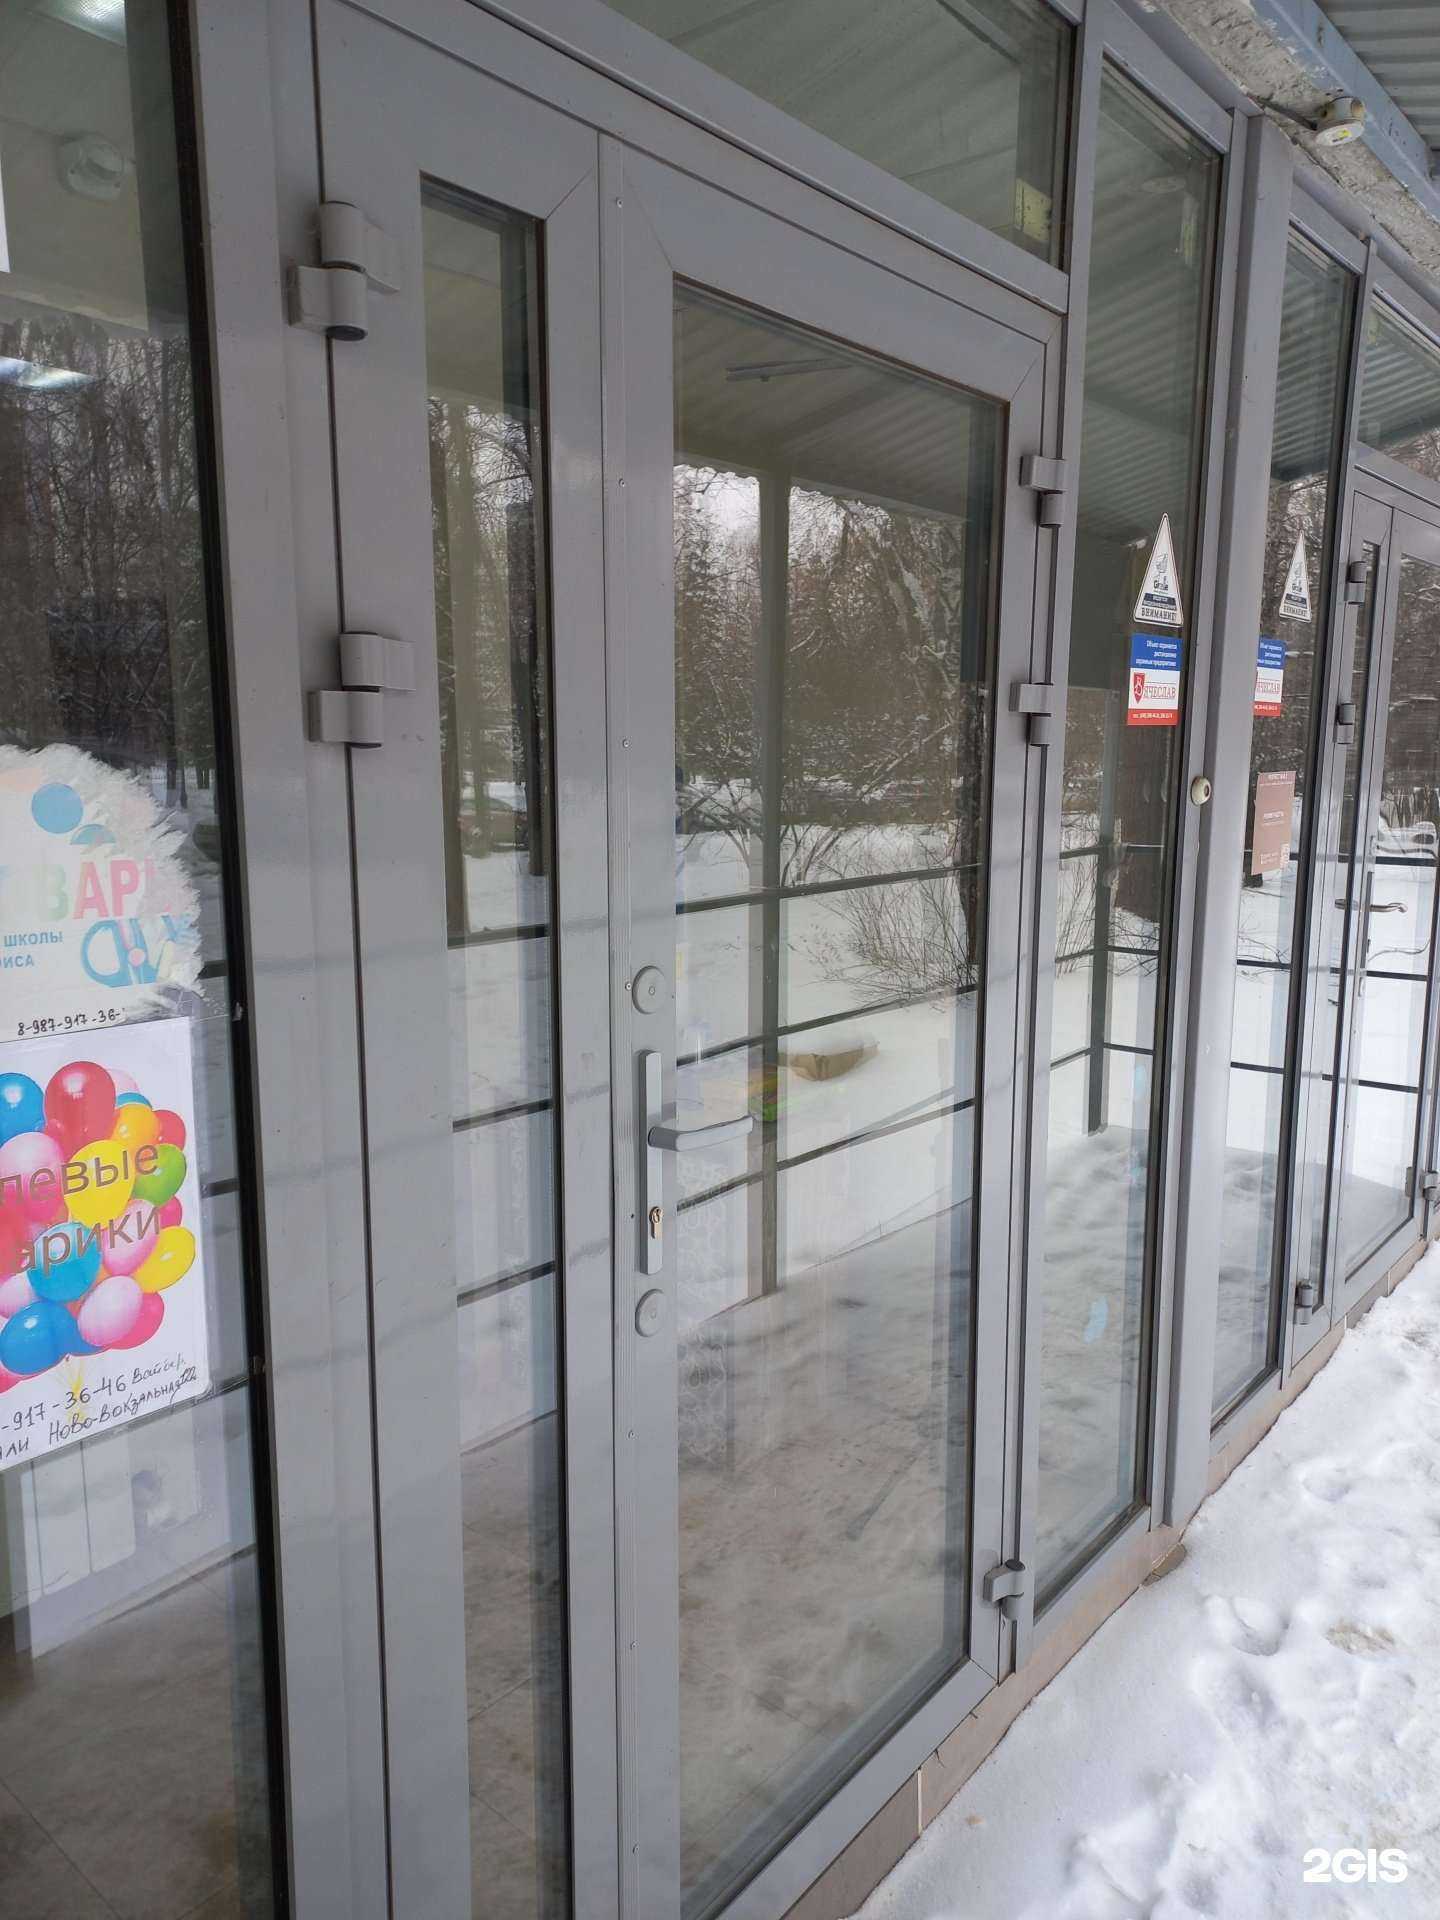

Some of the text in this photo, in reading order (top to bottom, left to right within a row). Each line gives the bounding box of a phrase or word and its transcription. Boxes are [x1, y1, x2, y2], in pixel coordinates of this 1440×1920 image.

[3, 931, 63, 948] ШКОЛЫ
[0, 954, 35, 969] ИСА
[17, 1007, 126, 1037] 8-987-917-36-
[0, 1436, 29, 1460] ЛИ
